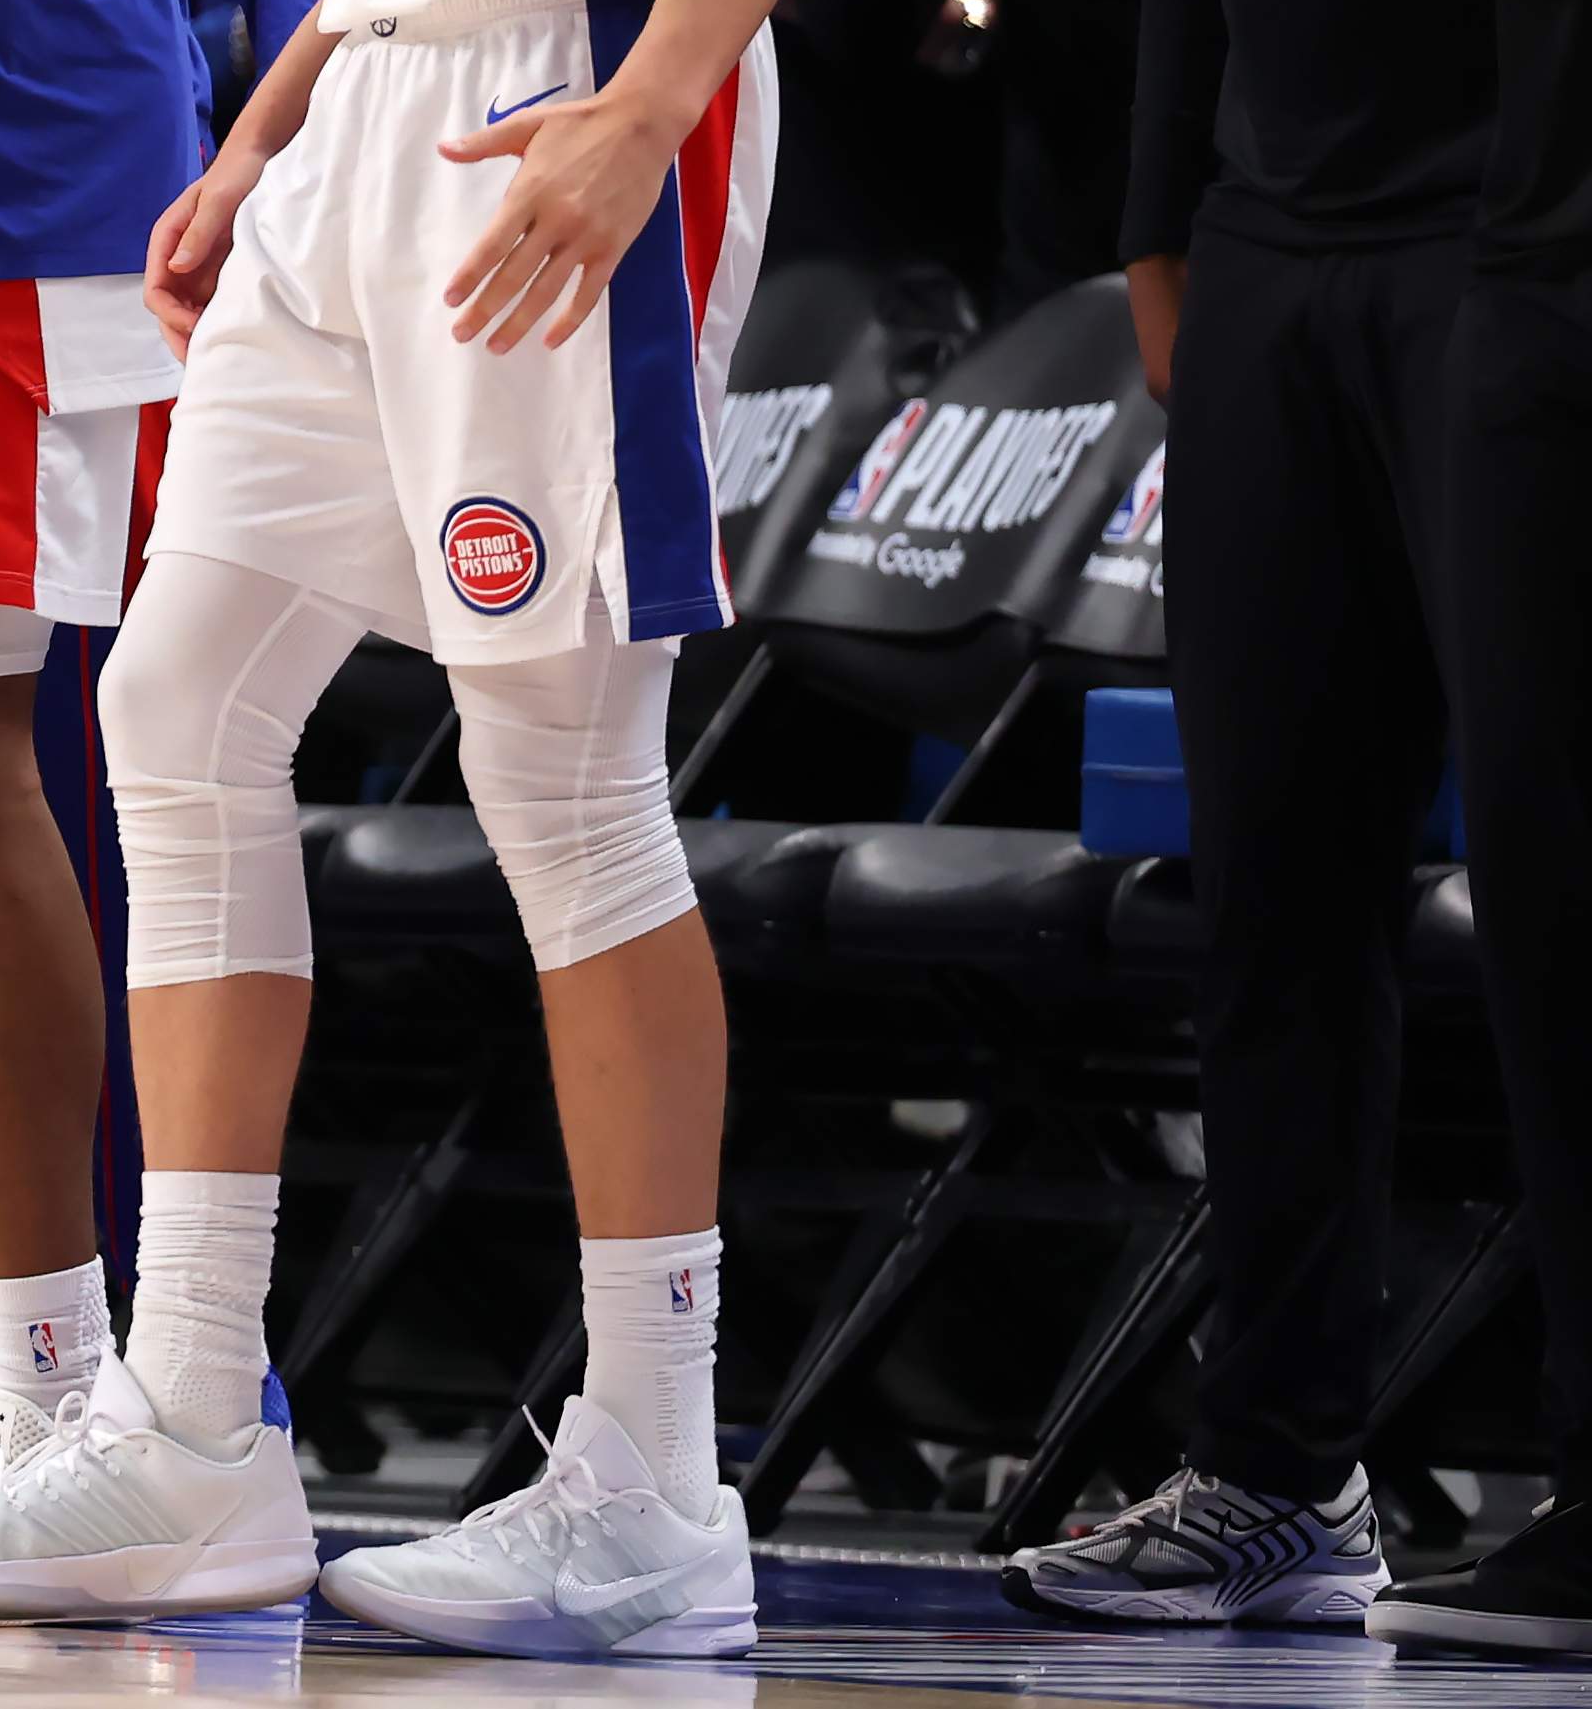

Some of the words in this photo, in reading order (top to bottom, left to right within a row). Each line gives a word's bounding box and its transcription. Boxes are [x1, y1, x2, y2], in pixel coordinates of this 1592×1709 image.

[870, 399, 1115, 532] PLAYOFFS
[454, 532, 517, 559] DETROIT
[457, 552, 523, 579] PISTONS
[876, 532, 966, 589] Google
